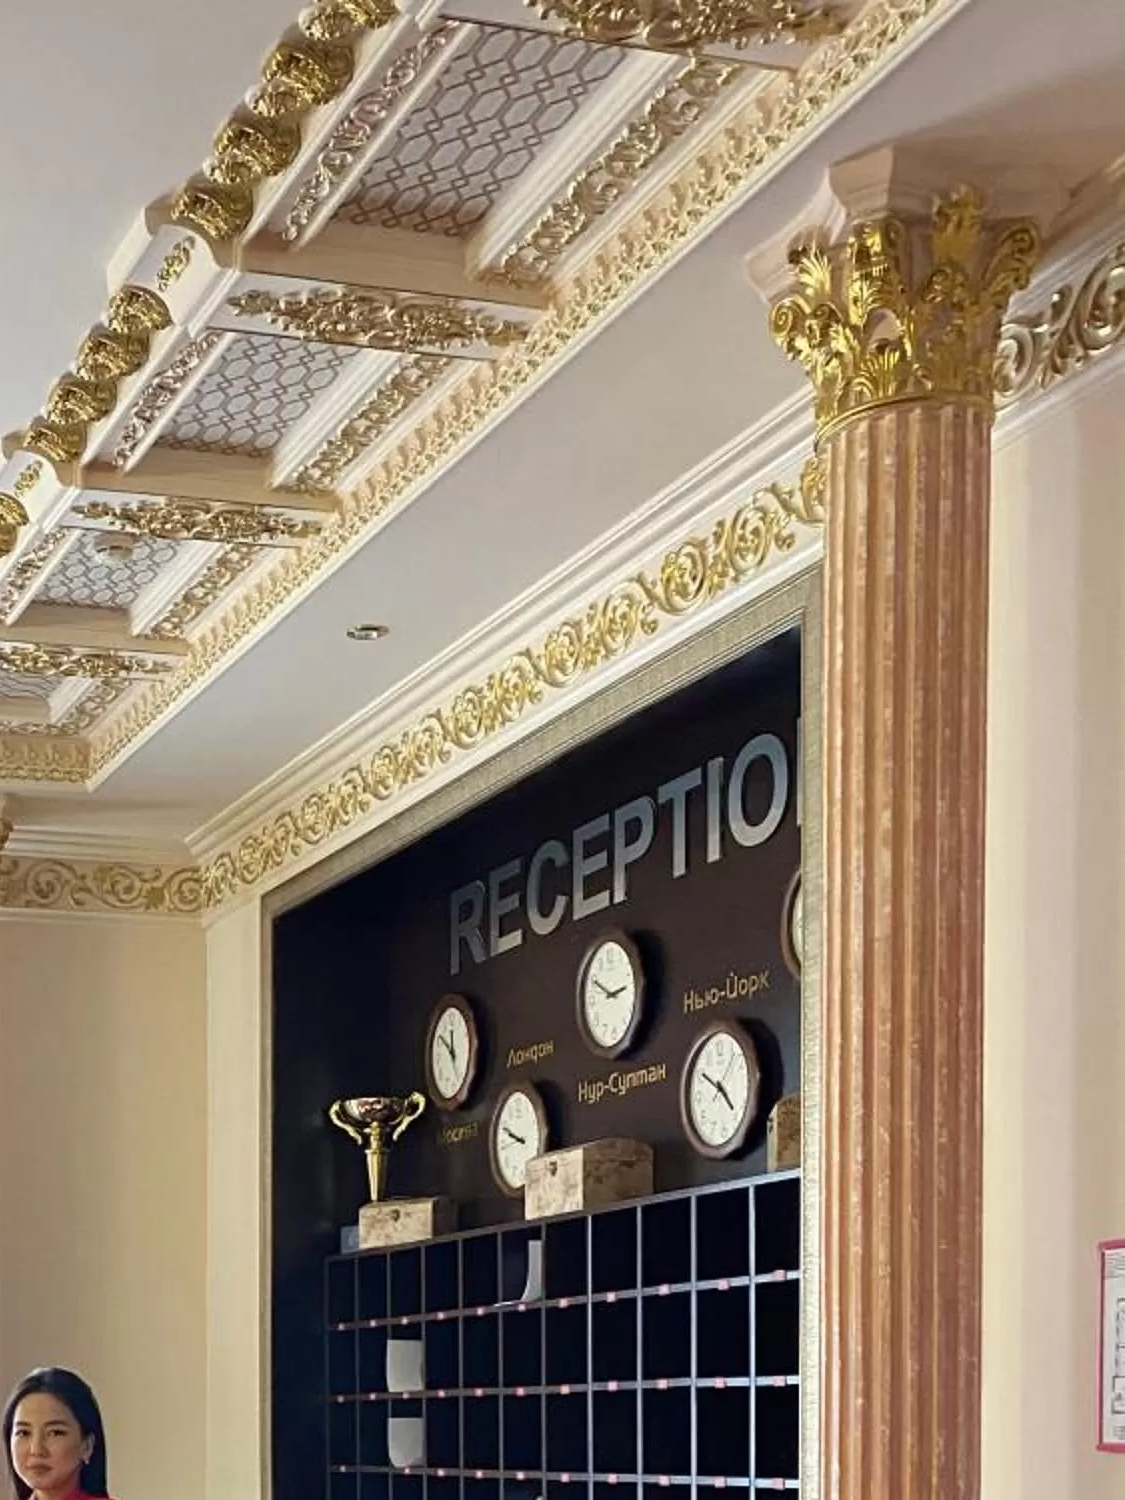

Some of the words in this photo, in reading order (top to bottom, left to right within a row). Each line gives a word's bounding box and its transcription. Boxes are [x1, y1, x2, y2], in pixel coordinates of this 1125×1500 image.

[450, 720, 802, 975] RECEPTIO
[684, 971, 770, 1013] Нью-Йорк
[507, 1040, 554, 1068] Лондон
[578, 1063, 667, 1103] Нур-Султан
